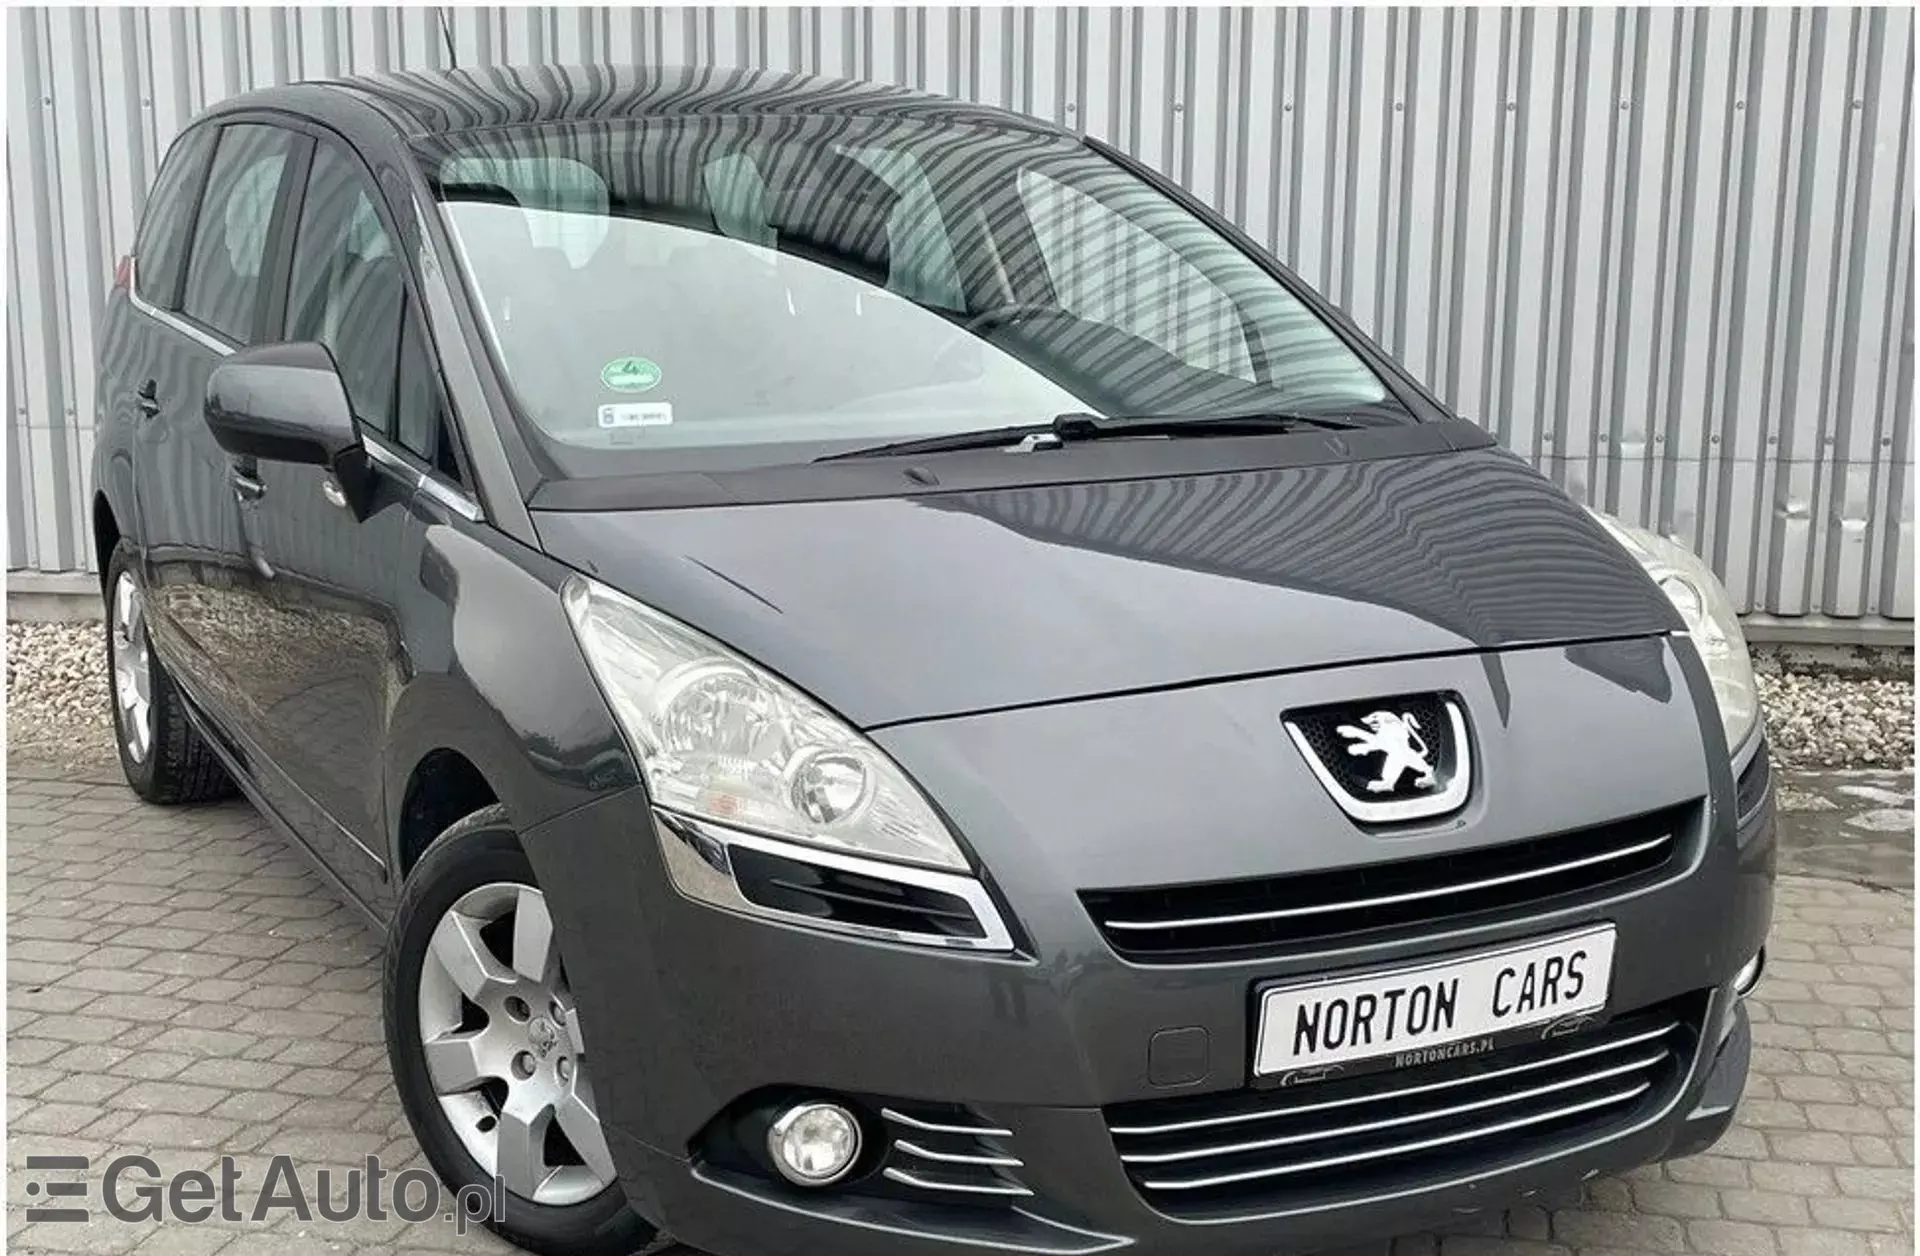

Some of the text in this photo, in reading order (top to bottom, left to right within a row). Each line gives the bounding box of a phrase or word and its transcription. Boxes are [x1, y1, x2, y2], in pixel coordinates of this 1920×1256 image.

[622, 360, 640, 375] 4
[1293, 950, 1587, 1056] NORTON CARS
[1395, 1037, 1495, 1068] NORTONCARS.PL
